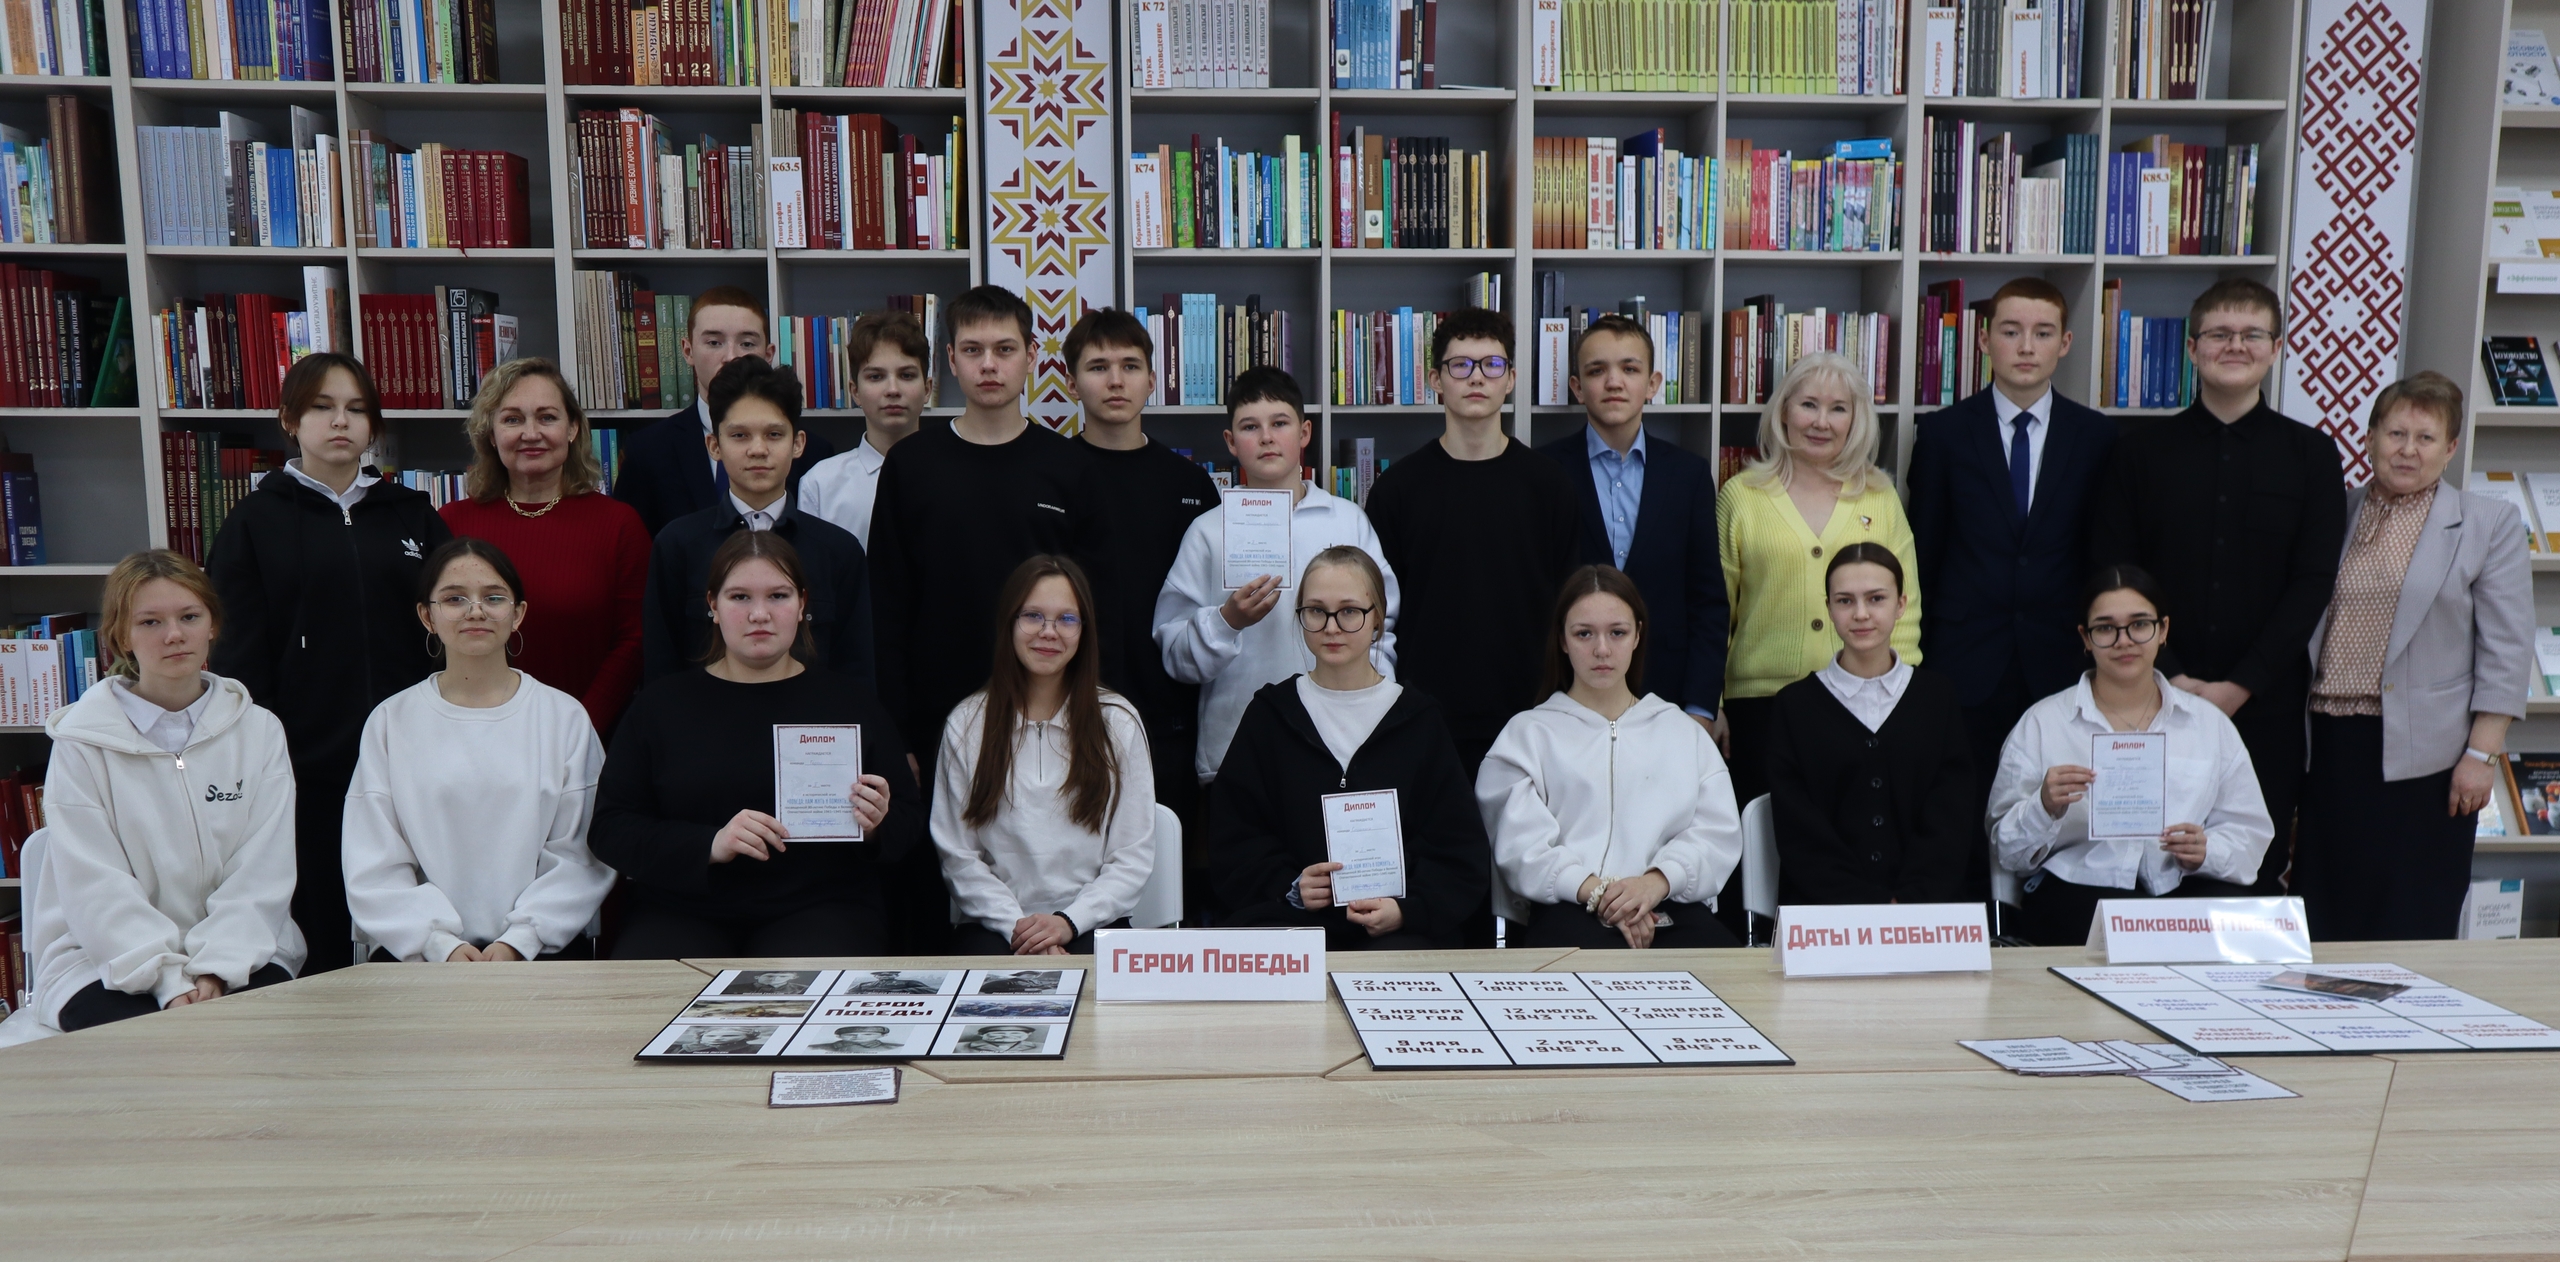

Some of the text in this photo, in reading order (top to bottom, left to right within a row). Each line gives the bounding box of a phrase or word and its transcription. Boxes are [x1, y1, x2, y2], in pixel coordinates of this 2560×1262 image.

[1142, 1, 1165, 11] К 72
[1538, 1, 1557, 10] К82
[1928, 11, 1955, 20] К85.13
[2014, 13, 2041, 21] К85.14
[1184, 3, 1192, 43] НИКОЛЬСКИЙ
[1156, 23, 1166, 86] Науковедение
[1145, 56, 1154, 86] Наука.
[1932, 41, 1943, 95] Скульптура
[2019, 50, 2027, 96] Живопись
[626, 124, 638, 205] ДРЕВНИЕ БОЛГАРО-ЧУВАШИ
[1134, 163, 1155, 173] К74
[2142, 173, 2170, 183] К85.3
[249, 173, 257, 216] ЧЕБОКСАРЫ
[260, 199, 269, 240] ЧЕБОКСАРЫ
[777, 201, 785, 245] Этнография
[787, 202, 795, 246] (Этнология,
[794, 190, 804, 246] народоведение)
[1144, 191, 1152, 246] педагогические
[311, 276, 321, 334] ЭНЦИКЛОПЕДИЯ
[57, 299, 66, 335] ЖИВОТНЫЙ
[71, 299, 80, 335] ЖИВОТНЫЙ
[1545, 323, 1565, 333] К83
[1551, 336, 1559, 404] Литературоведение
[190, 470, 198, 497] ПОМНИ
[1217, 477, 1228, 486] 76
[1241, 498, 1272, 507] Диплом
[181, 505, 189, 528] ЖИВИ
[1, 644, 17, 653] К5
[32, 643, 49, 651] К60
[10, 677, 18, 725] Медицинские
[32, 678, 40, 725] Социальные
[799, 734, 836, 744] Диплом
[2112, 741, 2145, 750] Диплом
[1343, 802, 1376, 812] Диплом
[1112, 948, 1310, 976] ГЕРОИ ПОБЕДЫ
[824, 1008, 934, 1017] ПОБЕДЫ
[843, 999, 927, 1009] ГЕРОИ
[1687, 1012, 1725, 1020] ГОД
[1420, 1039, 1460, 1047] МАЯ
[1663, 1043, 1761, 1051] 1945 ГОД
[1694, 1036, 1734, 1044] МАЯ
